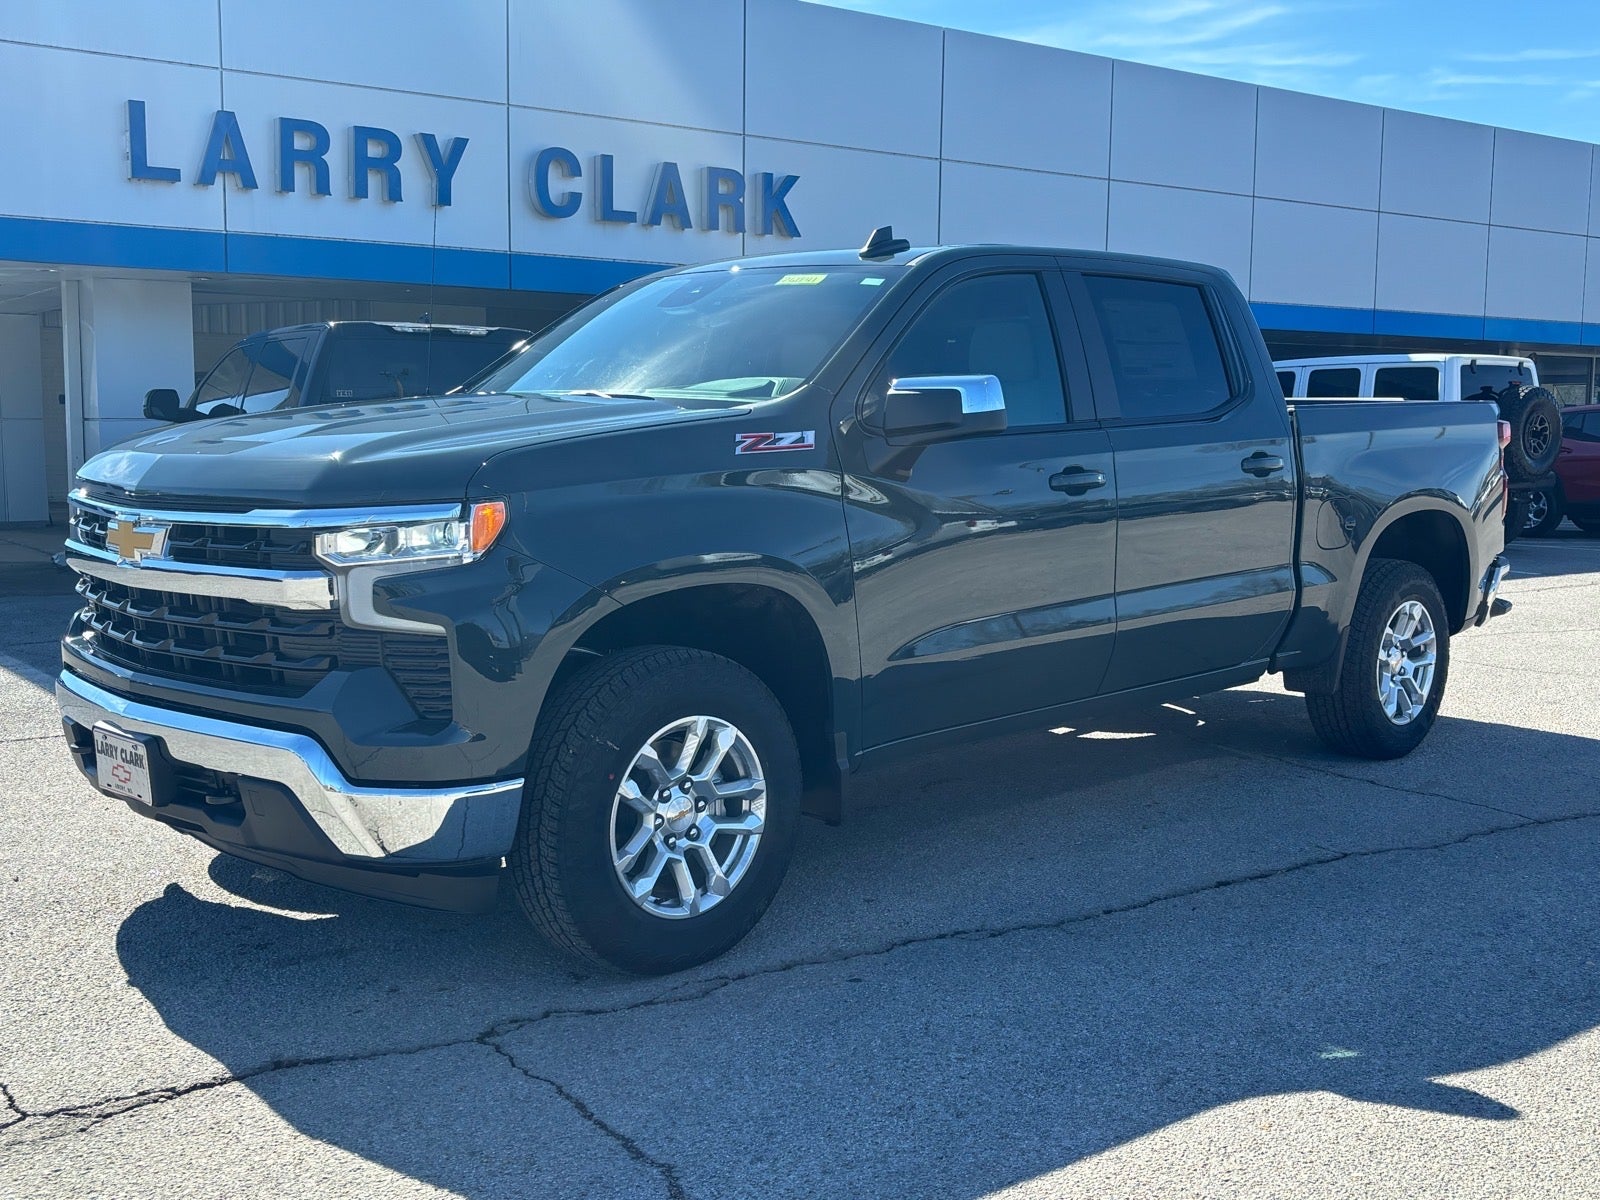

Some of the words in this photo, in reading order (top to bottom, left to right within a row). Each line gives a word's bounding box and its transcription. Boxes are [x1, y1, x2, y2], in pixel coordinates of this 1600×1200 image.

[126, 99, 469, 207] LARRY
[528, 146, 801, 238] CLARK
[735, 430, 816, 455] Z71
[95, 739, 119, 760] LARRY
[120, 748, 145, 770] CLARK
